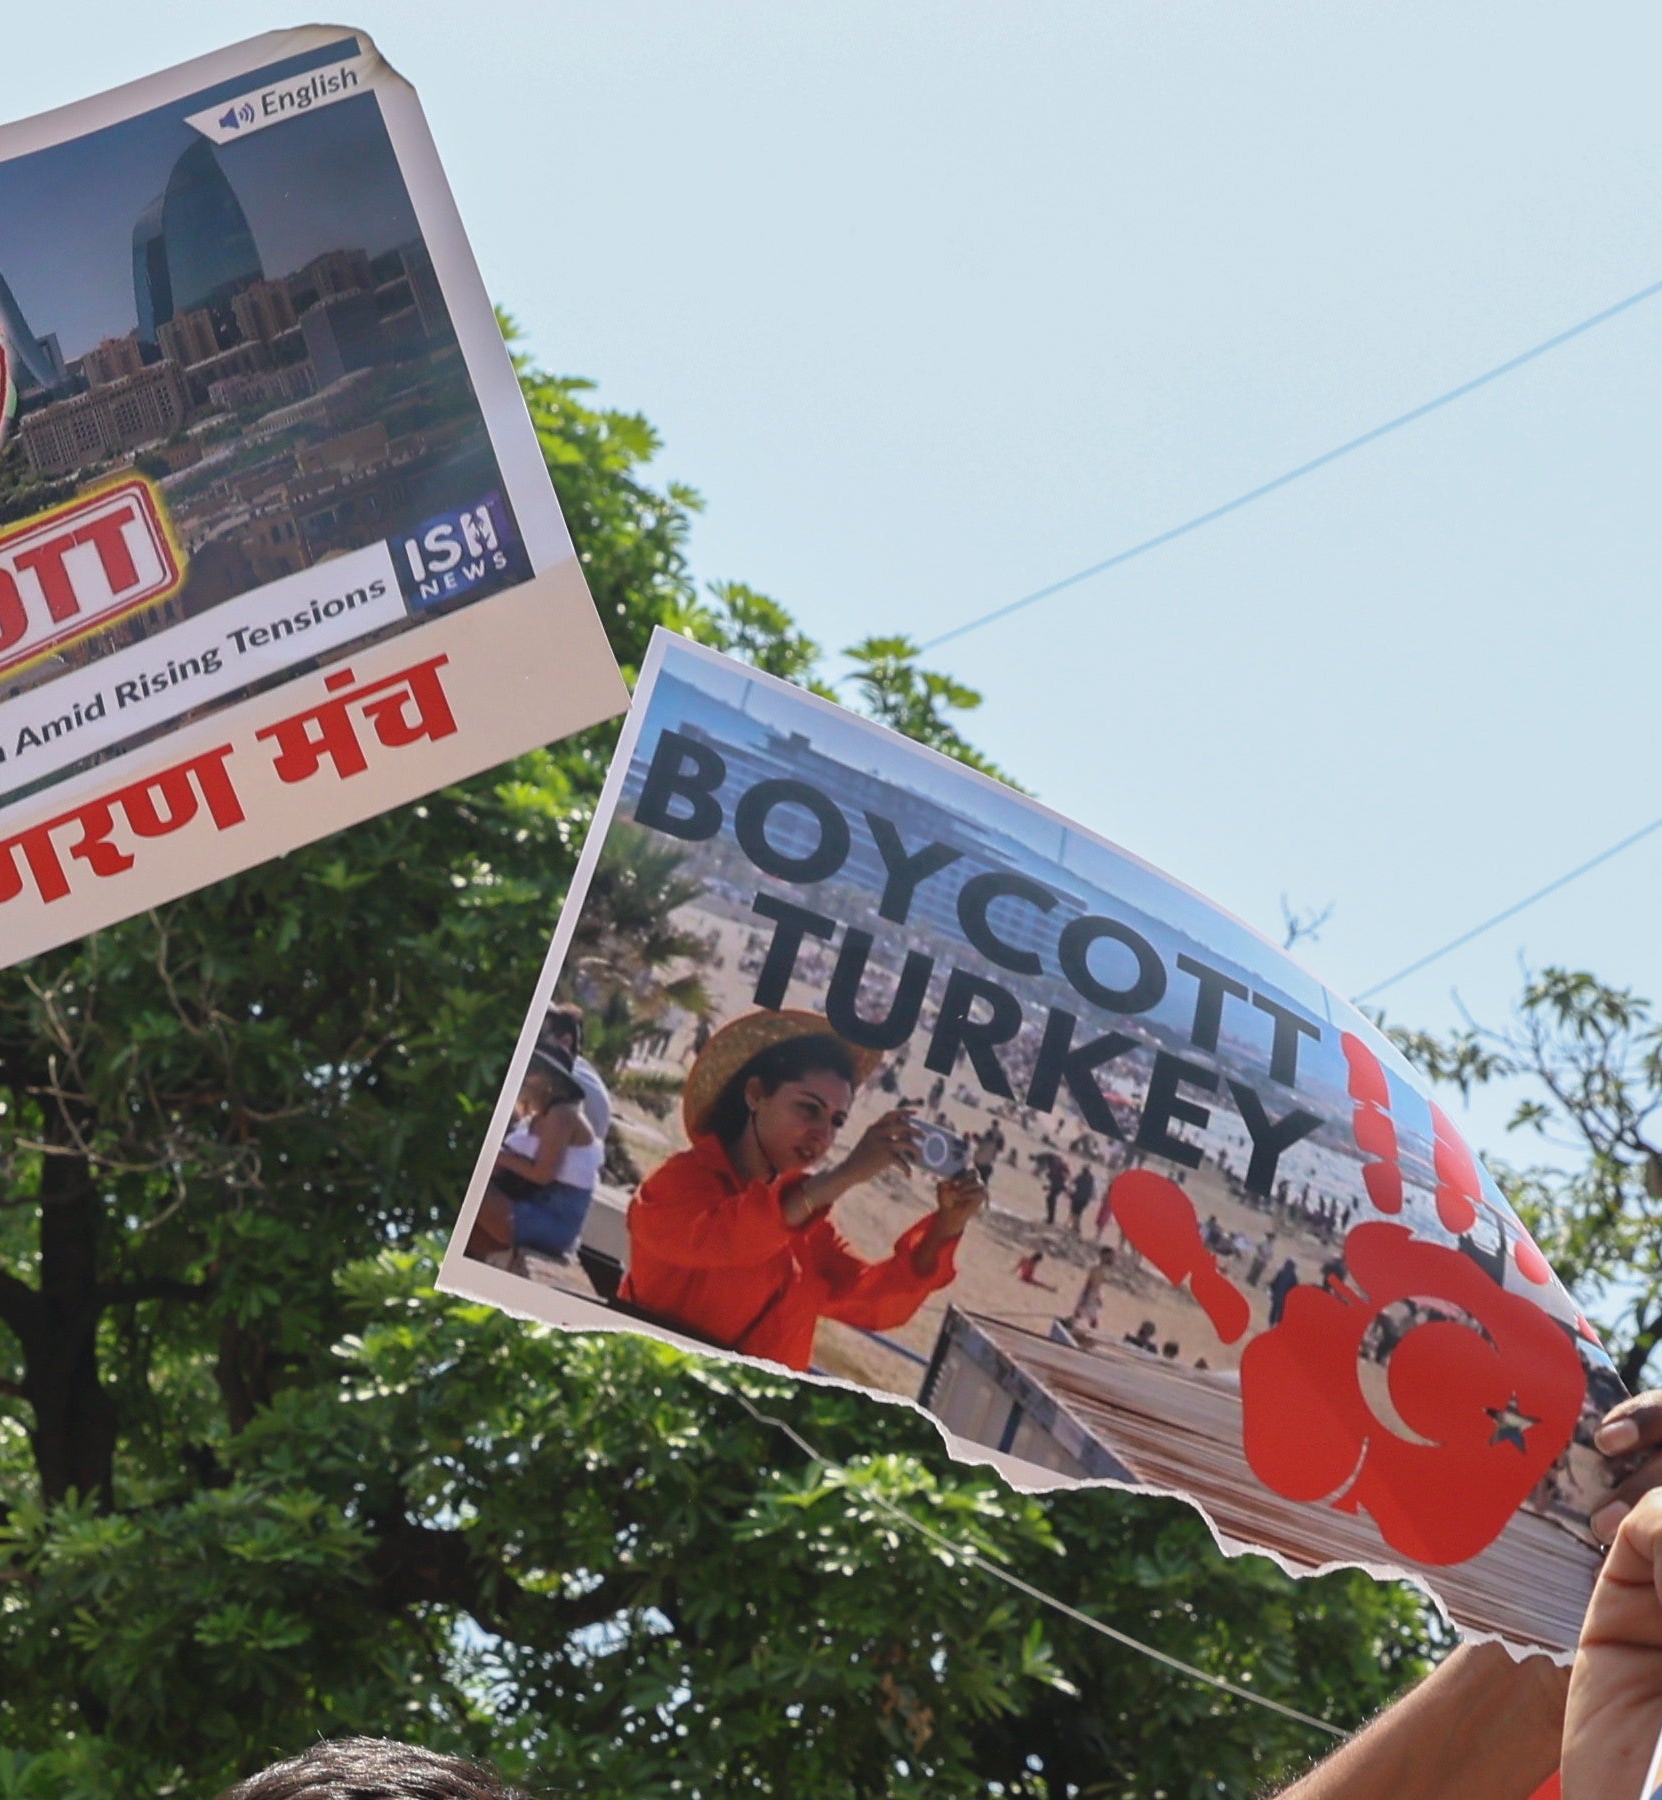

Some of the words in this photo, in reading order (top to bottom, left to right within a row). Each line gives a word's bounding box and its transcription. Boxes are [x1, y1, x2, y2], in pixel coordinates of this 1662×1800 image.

[261, 66, 359, 117] English
[404, 504, 499, 582] ISH
[418, 551, 508, 600] NEWS
[16, 692, 106, 758] Amid
[116, 643, 224, 709] Rising
[227, 575, 388, 656] Tensions
[255, 652, 457, 785] मंच
[633, 728, 1322, 1089] BOYCOTT
[752, 890, 1327, 1196] TURKEY
